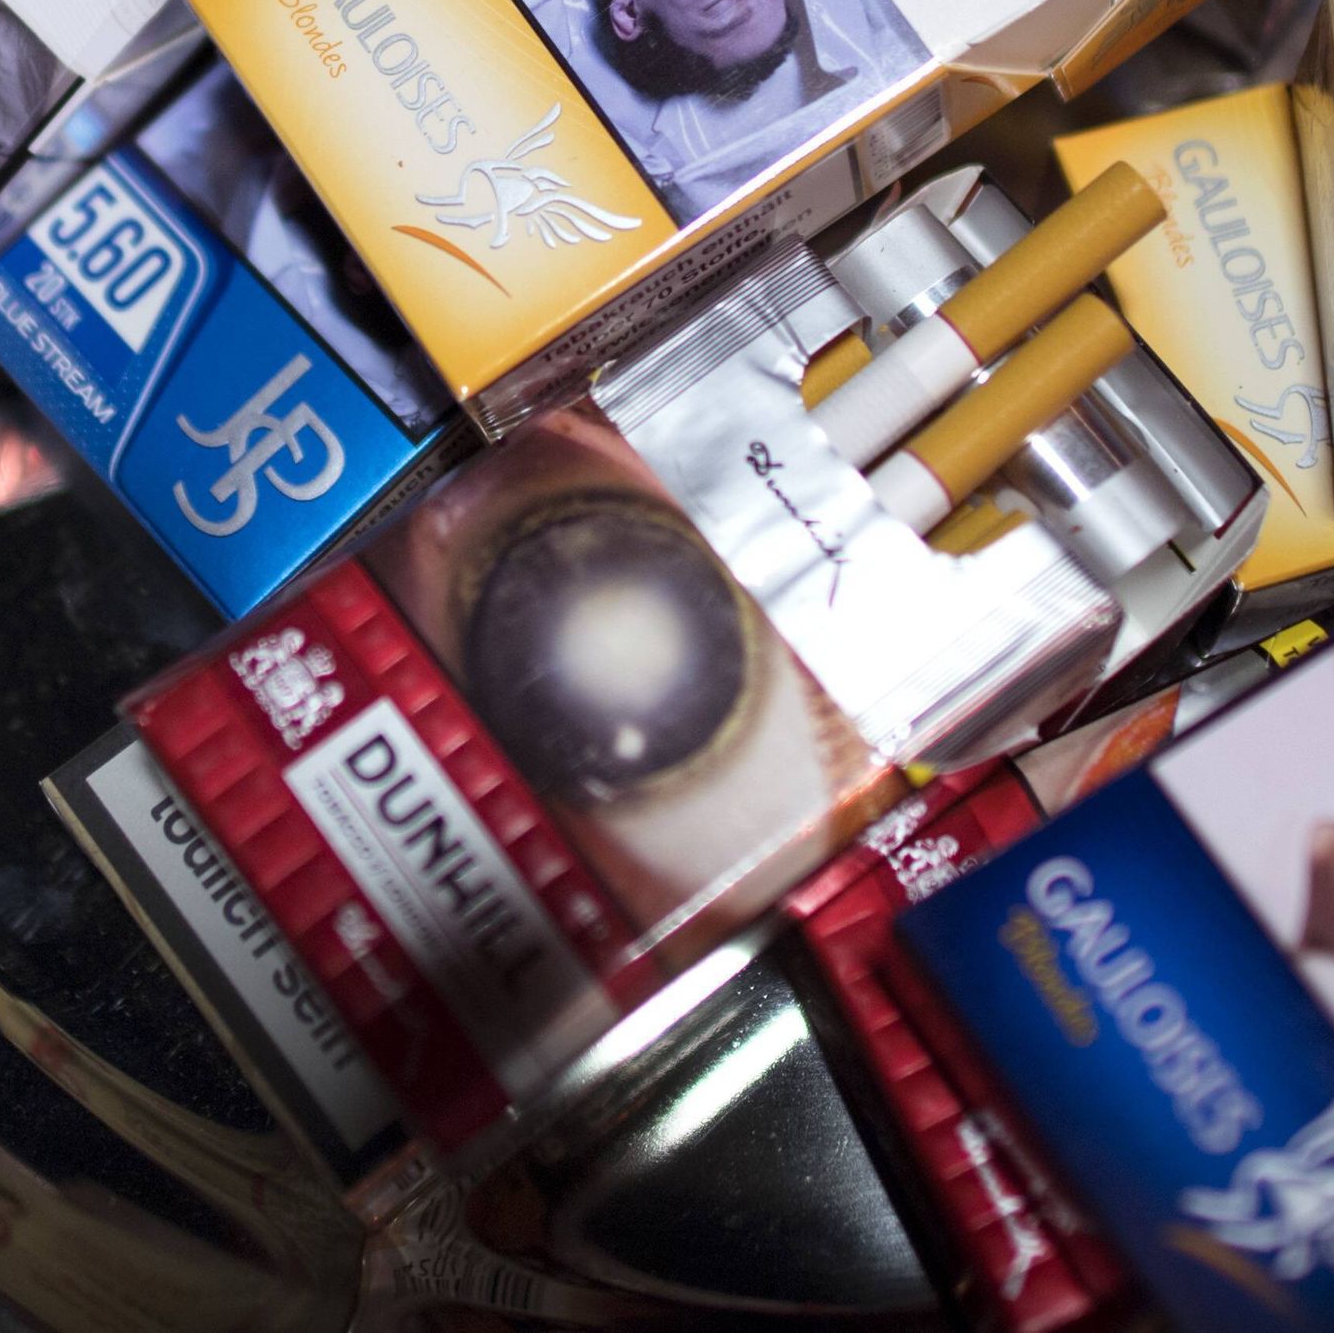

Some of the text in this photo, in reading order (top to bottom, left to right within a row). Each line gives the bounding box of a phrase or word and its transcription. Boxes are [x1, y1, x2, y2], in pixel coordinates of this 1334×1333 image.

[25, 262, 66, 304] 20
[50, 183, 171, 310] 5.60
[542, 188, 794, 364] Tabakrauch enthält
[643, 286, 674, 311] 70
[681, 227, 766, 285] Stoffe,
[1173, 139, 1305, 370] GAULOISES
[31, 332, 117, 424] STREAM
[1025, 856, 1267, 1155] GAULOISES
